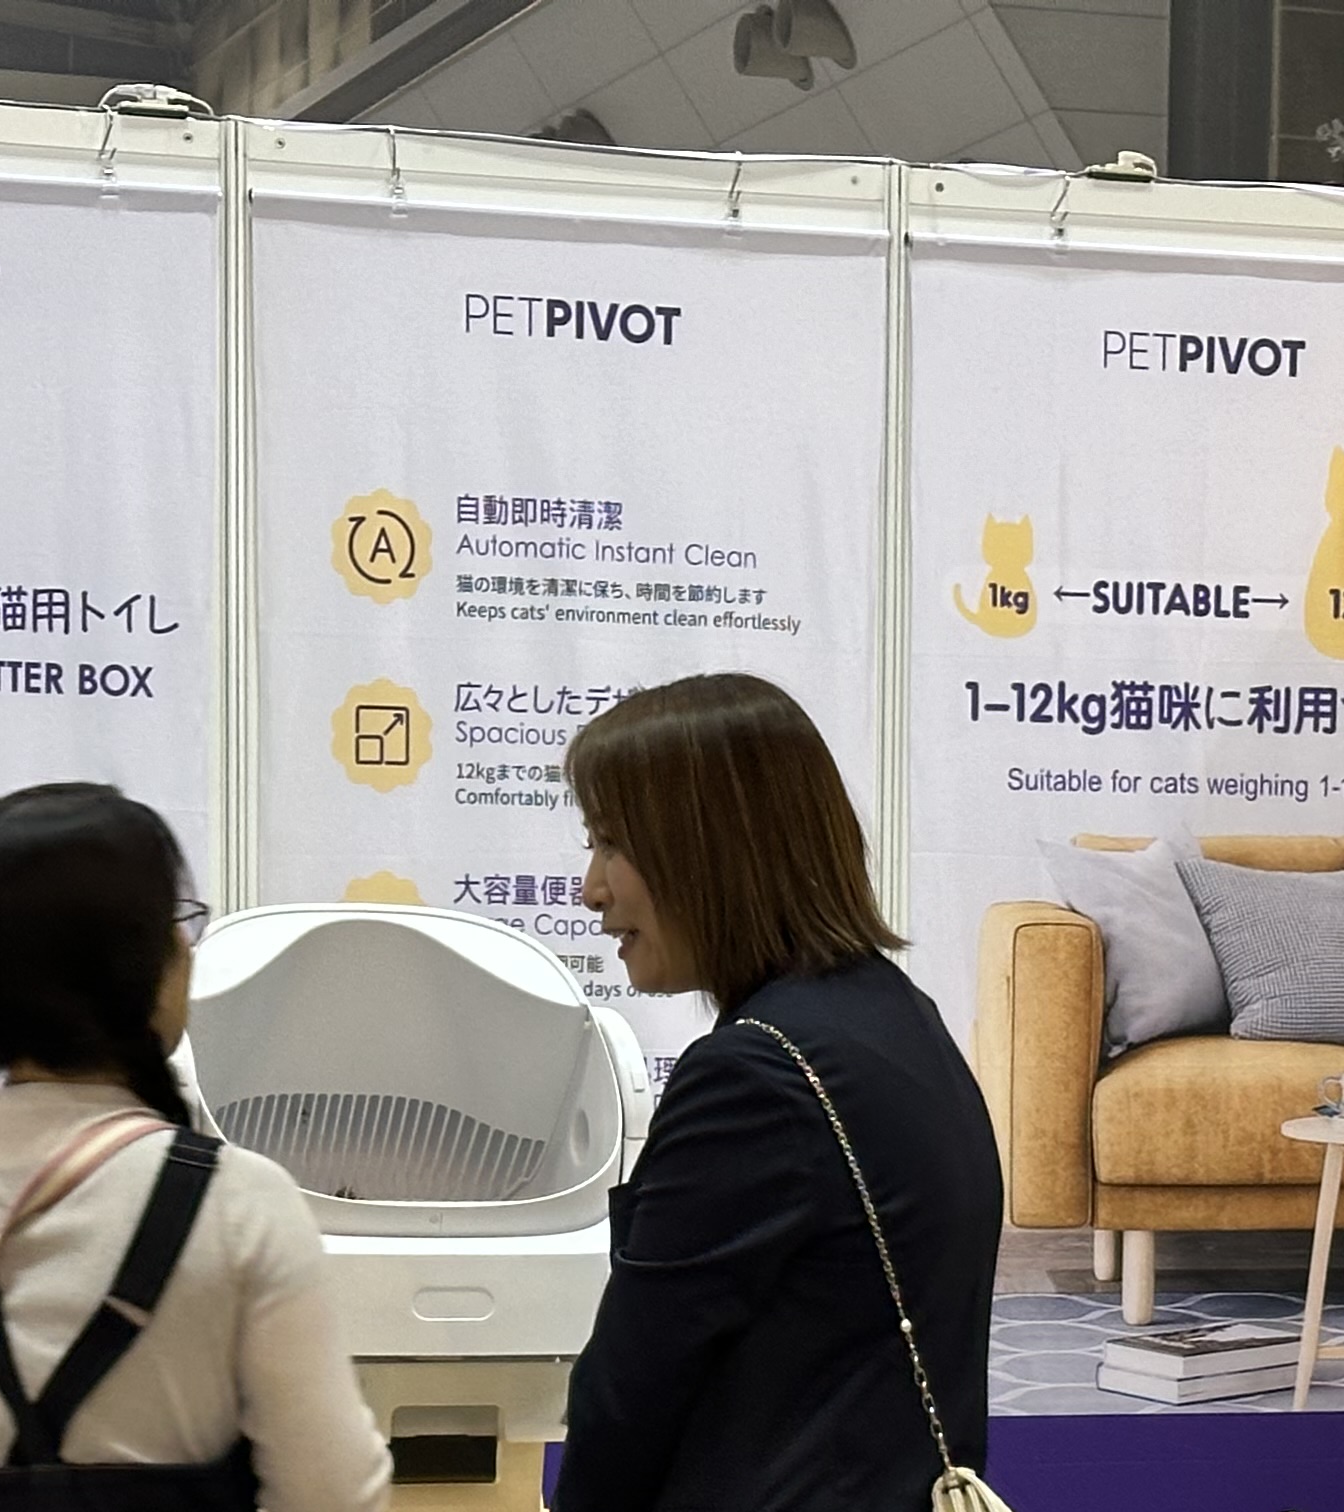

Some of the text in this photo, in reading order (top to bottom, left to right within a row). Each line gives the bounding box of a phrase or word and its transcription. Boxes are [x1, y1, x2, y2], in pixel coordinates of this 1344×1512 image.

[463, 293, 684, 346] PETPIVOT
[1101, 329, 1307, 379] PETPIVOT
[455, 493, 625, 532] 自動即時清潔
[455, 533, 759, 570] Automatic Instant Clean
[988, 583, 1029, 614] 1kg
[1092, 581, 1251, 619] SUITABLE
[456, 603, 506, 623] Keeps
[555, 606, 659, 627] environment
[663, 609, 708, 627] clean
[713, 611, 801, 636] effortlessly
[77, 662, 155, 700] BOX
[454, 721, 567, 748] Spacious
[455, 761, 568, 784] 12kgまでの猫
[1007, 767, 1102, 794] Suitable
[1110, 769, 1142, 795] for
[1149, 771, 1199, 797] cats
[1207, 773, 1309, 802] weighing
[455, 788, 558, 810] Comfortably
[583, 979, 622, 1000] days
